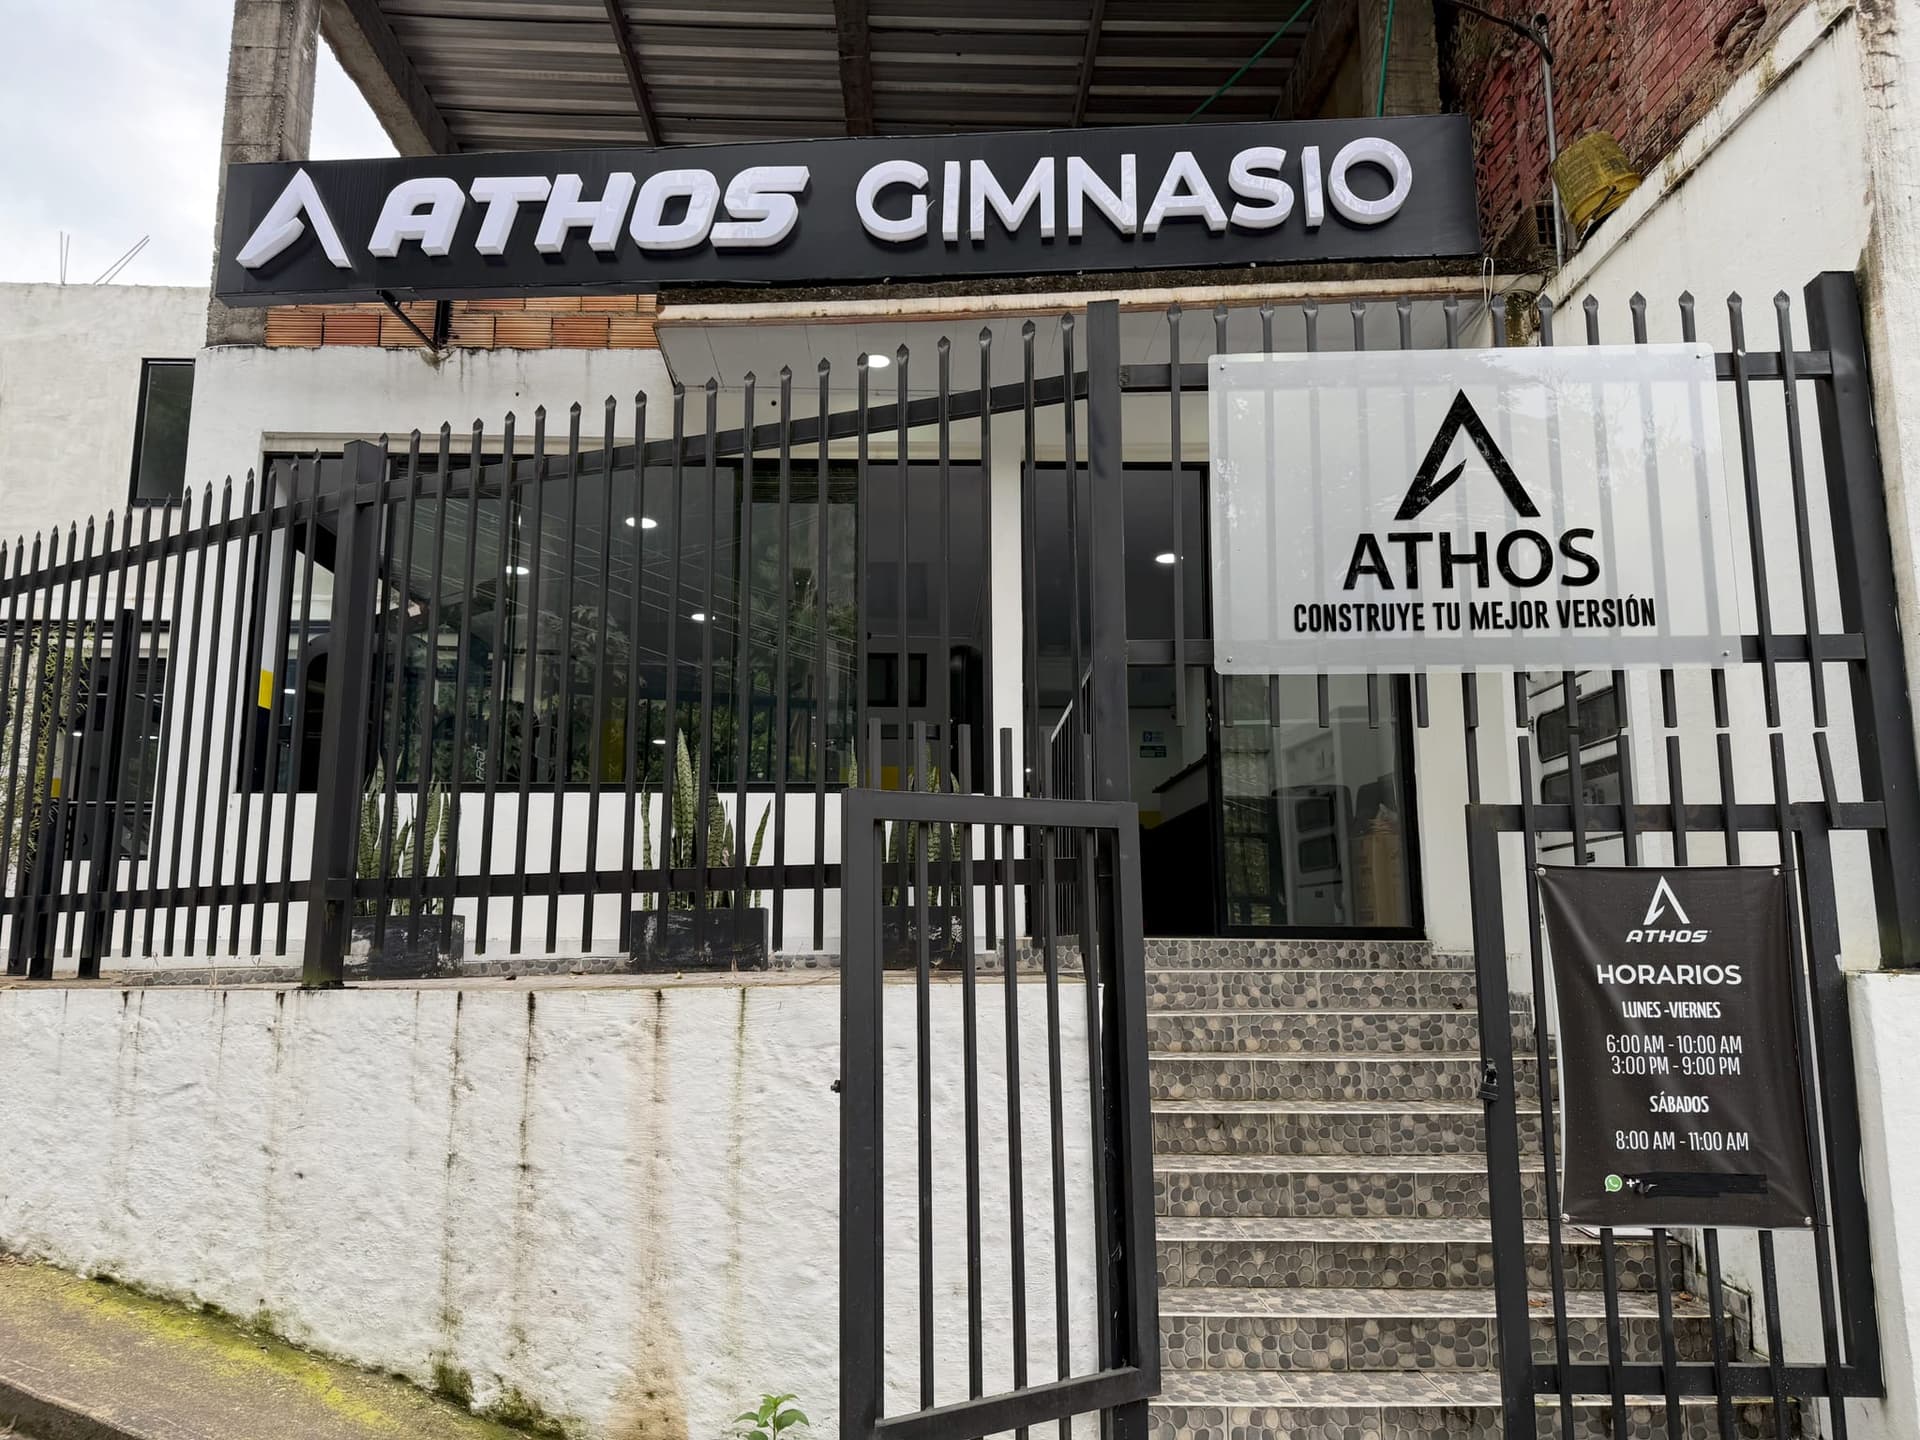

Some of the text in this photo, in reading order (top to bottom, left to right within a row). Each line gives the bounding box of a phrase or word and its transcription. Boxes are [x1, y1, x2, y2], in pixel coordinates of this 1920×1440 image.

[367, 136, 1414, 258] ATHOS GIMNASIO
[1342, 527, 1601, 591] ATHOS
[1293, 593, 1657, 633] CONSTRUYE TU MEJOR VERSIÓN
[1625, 929, 1710, 944] ATHOS
[1596, 963, 1743, 986] HORARIOS
[1621, 1000, 1662, 1019] LUNES
[1606, 1034, 1641, 1055] 6:00
[1643, 1034, 1665, 1054] AM
[1676, 1034, 1717, 1055] 10:00
[1719, 1035, 1743, 1055] AM
[1611, 1055, 1647, 1076] 3:00
[1649, 1055, 1670, 1076] PM
[1682, 1056, 1716, 1077] 9:00
[1718, 1056, 1741, 1076] PM
[1649, 1090, 1710, 1113] SÁBADOS
[1615, 1130, 1649, 1151] 8:00
[1652, 1131, 1676, 1151] AM
[1687, 1131, 1723, 1152] 11:00
[1725, 1131, 1750, 1152] AM
